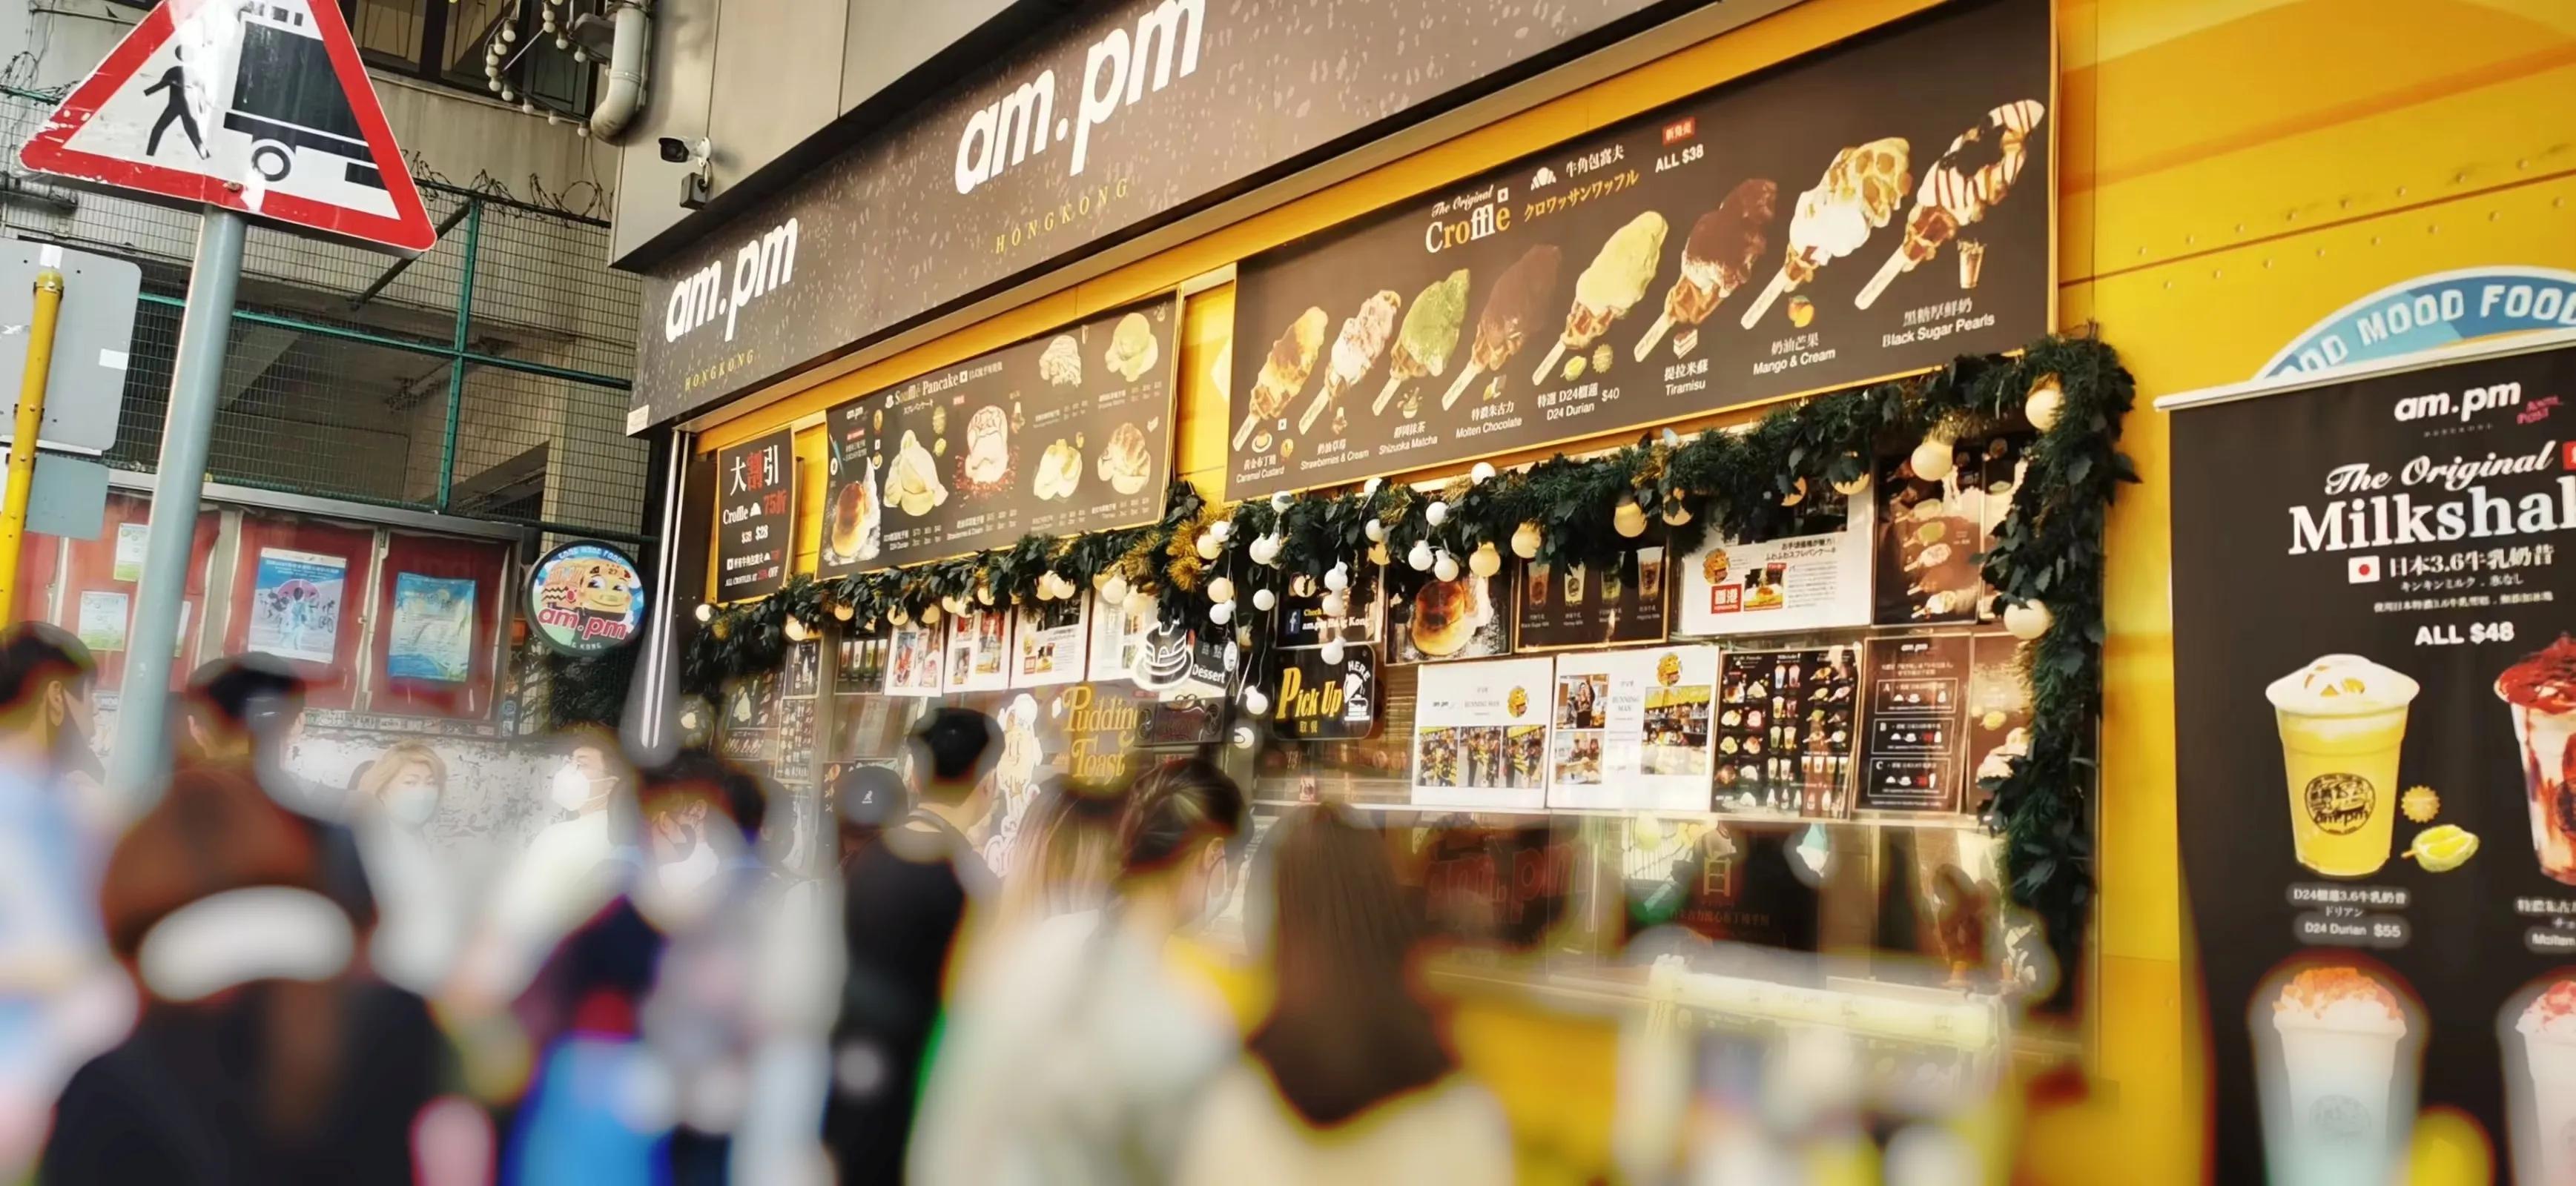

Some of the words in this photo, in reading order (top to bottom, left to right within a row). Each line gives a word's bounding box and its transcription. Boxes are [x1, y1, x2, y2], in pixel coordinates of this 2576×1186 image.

[955, 0, 1206, 195] am.pm
[1655, 155, 1680, 173] ALL
[1682, 143, 1705, 165] $38
[1431, 201, 1450, 219] The
[1453, 184, 1495, 211] Original
[1524, 169, 1639, 223] クロワッサンワッフル
[994, 177, 1130, 255] HONGKONG
[1425, 203, 1511, 254] Croffle
[664, 216, 799, 343] am.pm
[1882, 329, 1915, 348] Black
[1918, 323, 1954, 344] Sugar
[1955, 313, 1996, 332] Pearls
[2357, 289, 2465, 347] MOOD
[683, 350, 756, 394] HONGKONG
[1752, 360, 1788, 376] Mango
[1789, 357, 1798, 368] &
[1800, 348, 1837, 365] Cream
[922, 373, 959, 396] Pancake
[1601, 387, 1620, 403] $40
[1665, 380, 1706, 397] Tiramisu
[1547, 406, 1564, 421] D24
[1565, 402, 1595, 417] Durian
[2394, 381, 2522, 422] am.pm
[1456, 425, 1482, 440] Molten
[1482, 416, 1523, 434] Chocolate
[1347, 448, 1370, 463] Cream
[1378, 439, 1410, 455] Shizuoka
[1411, 434, 1438, 449] Matcha
[2325, 463, 2393, 495] The
[2401, 440, 2555, 491] Original
[537, 607, 628, 641] am.pm
[2414, 625, 2465, 646] ALL
[2469, 621, 2515, 645] $48
[1192, 663, 1225, 683] Dessert
[1347, 660, 1371, 683] HERE
[1275, 666, 1318, 720] Pick
[1320, 680, 1343, 718] Up
[1071, 735, 1126, 784] Toast
[2325, 905, 2364, 918] ドリアン
[2305, 921, 2328, 934] D24
[2329, 923, 2368, 936] Durian
[2374, 923, 2402, 938] $55
